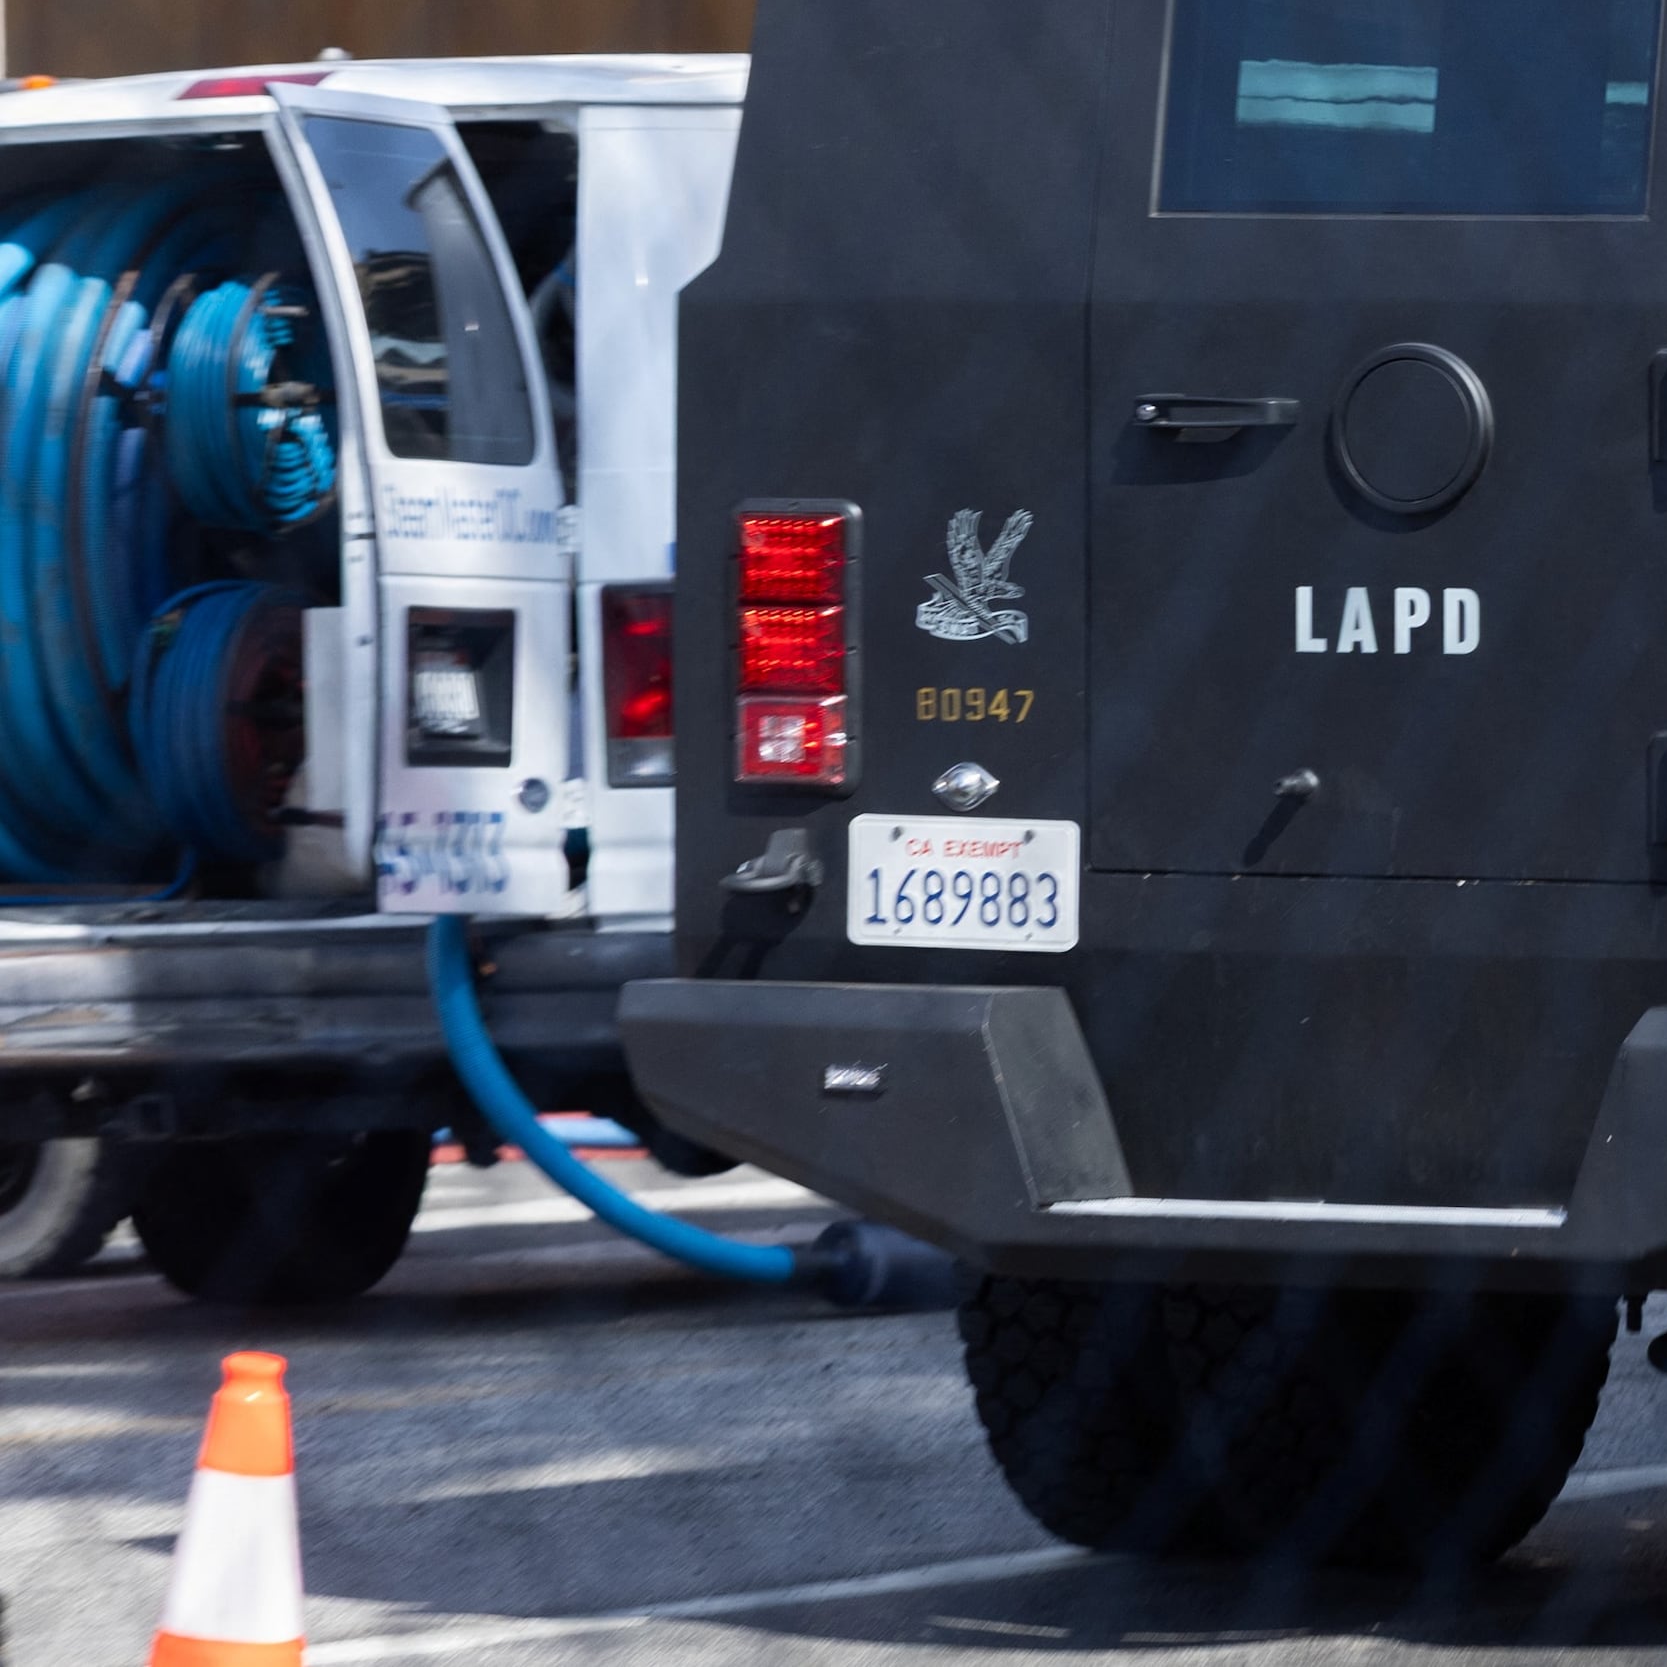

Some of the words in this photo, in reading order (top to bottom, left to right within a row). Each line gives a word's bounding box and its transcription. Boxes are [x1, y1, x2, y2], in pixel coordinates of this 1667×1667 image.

[1295, 585, 1481, 655] LAPD
[906, 838, 933, 857] CA
[943, 839, 1024, 859] EXEMPT
[865, 867, 1058, 929] 1689883
